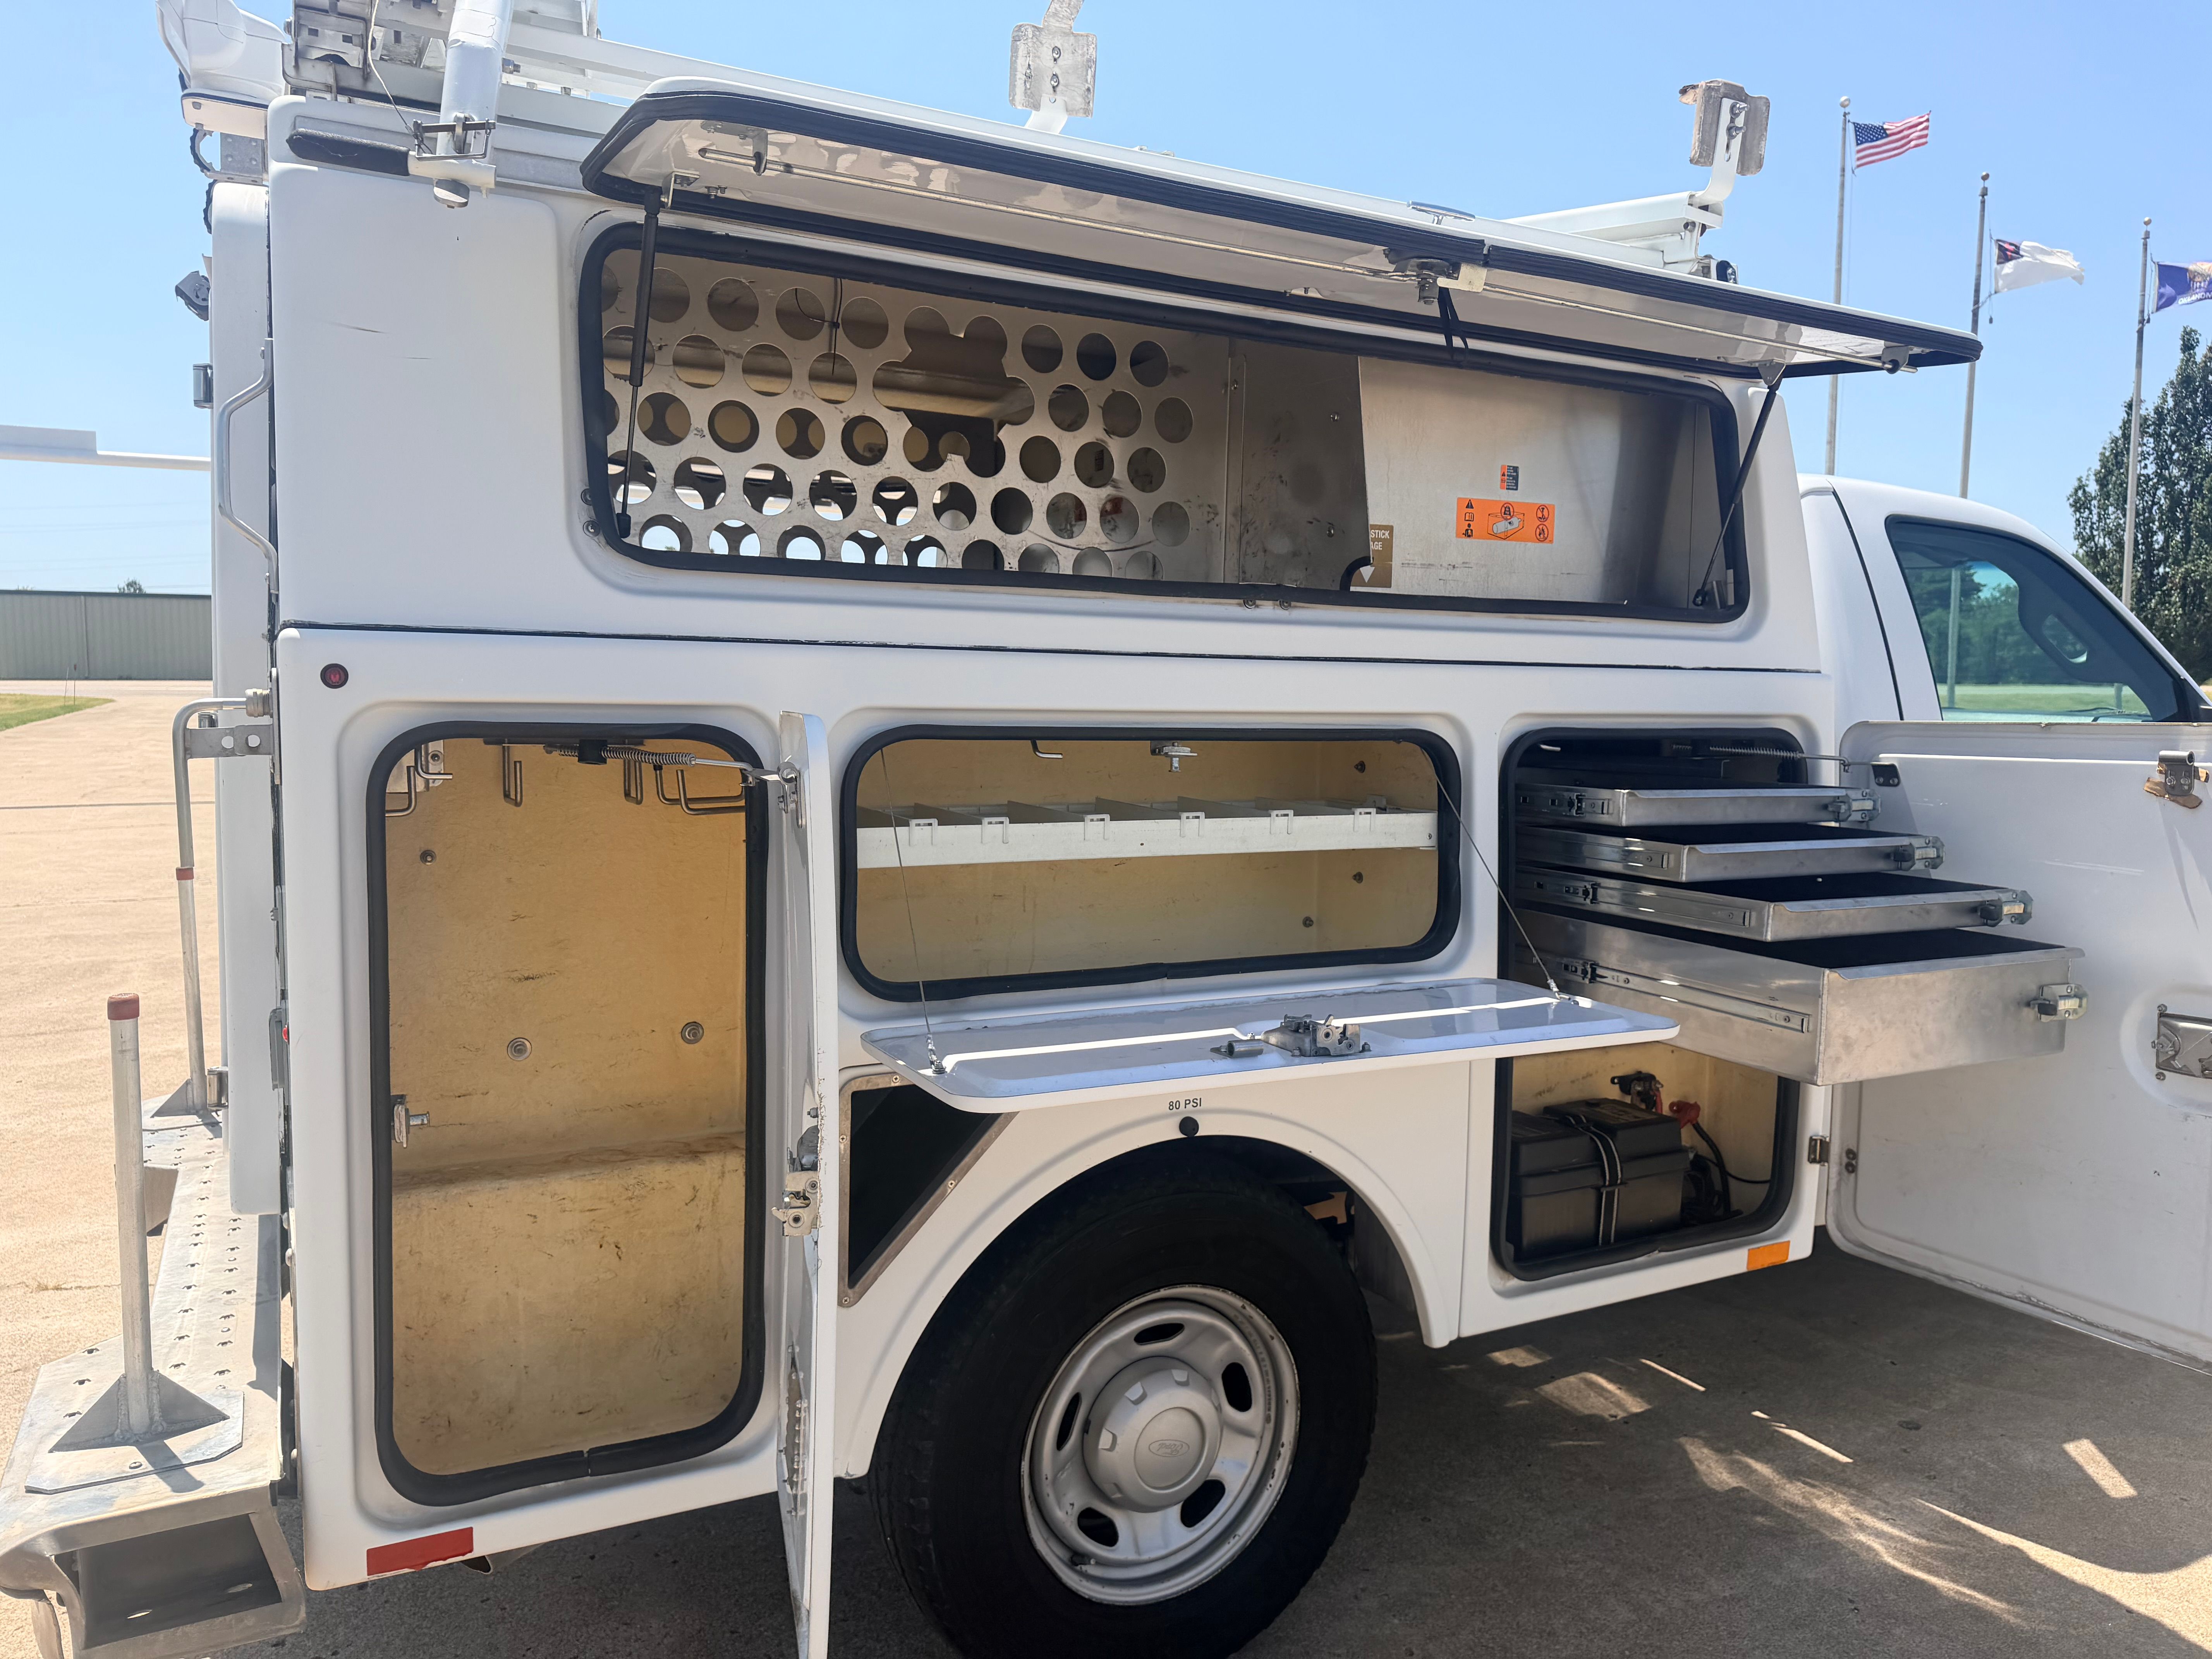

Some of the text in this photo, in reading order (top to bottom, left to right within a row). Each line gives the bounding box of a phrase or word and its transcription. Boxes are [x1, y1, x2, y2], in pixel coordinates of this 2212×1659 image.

[1371, 529, 1389, 539] STICK
[1168, 1097, 1201, 1110] 80 PSI
[1156, 1442, 1183, 1455] Ford
